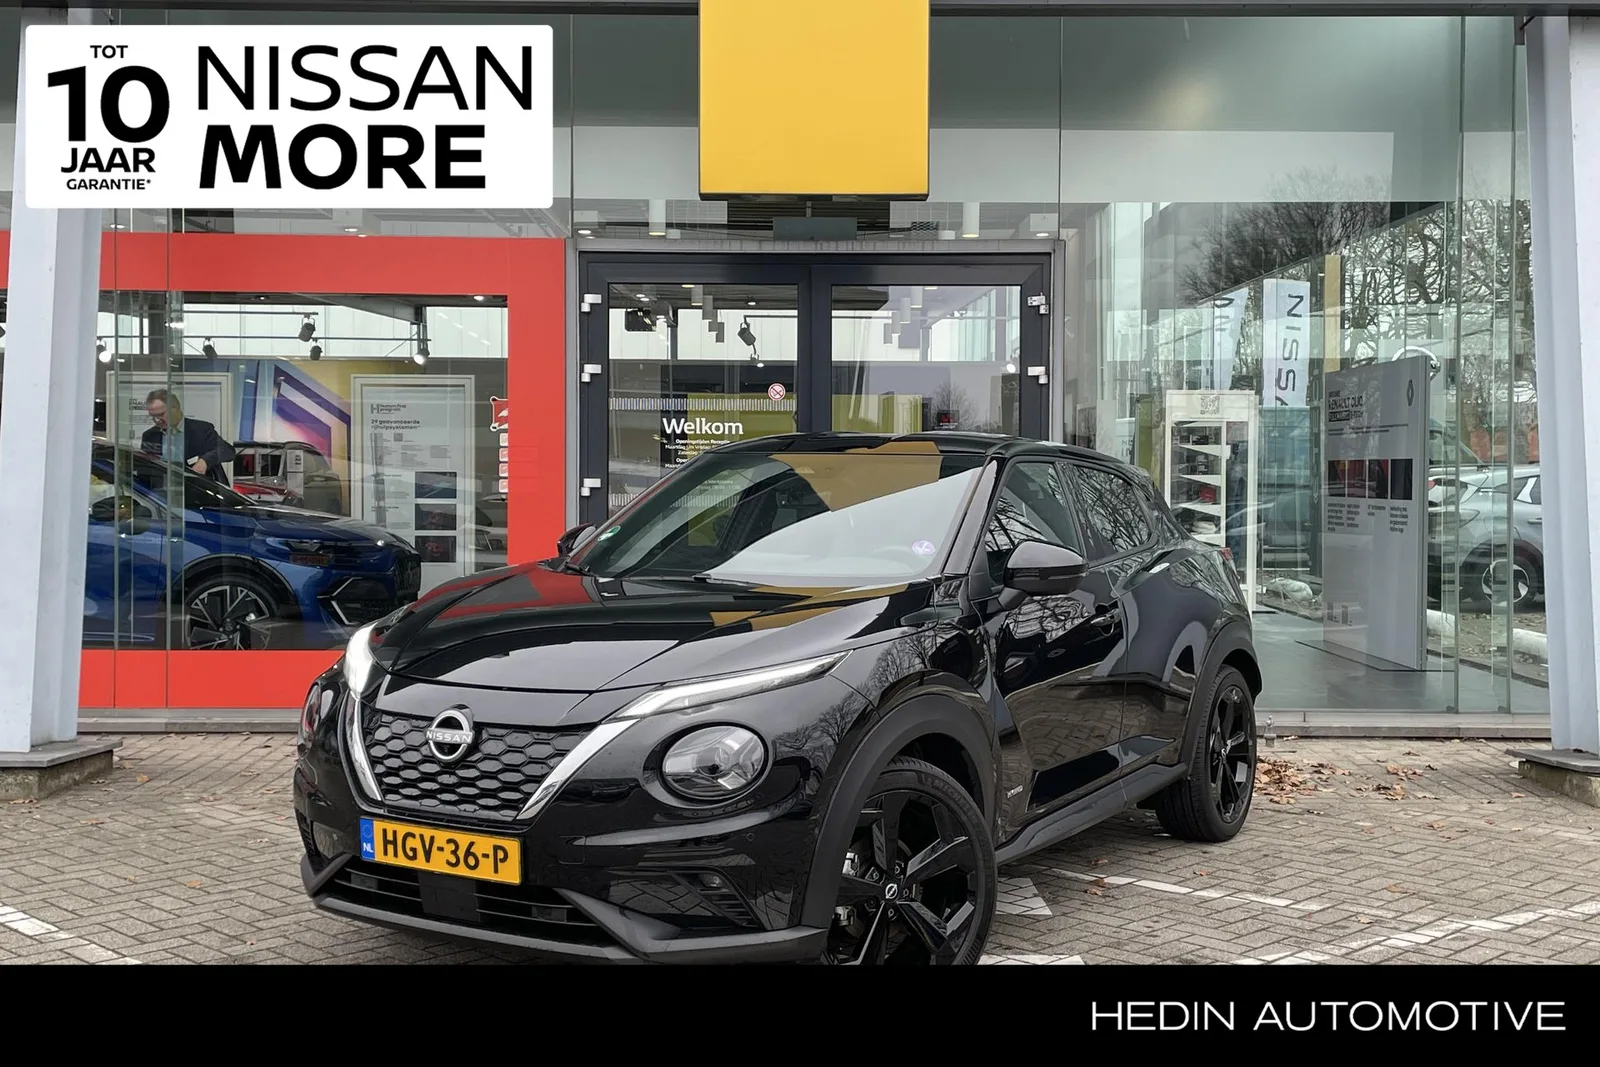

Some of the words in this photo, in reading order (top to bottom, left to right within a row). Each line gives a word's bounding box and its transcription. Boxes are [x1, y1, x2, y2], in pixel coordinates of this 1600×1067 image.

[662, 417, 744, 435] Welkom
[426, 730, 471, 743] NISSAN
[362, 842, 374, 853] NL
[381, 828, 509, 875] HGV-36-P
